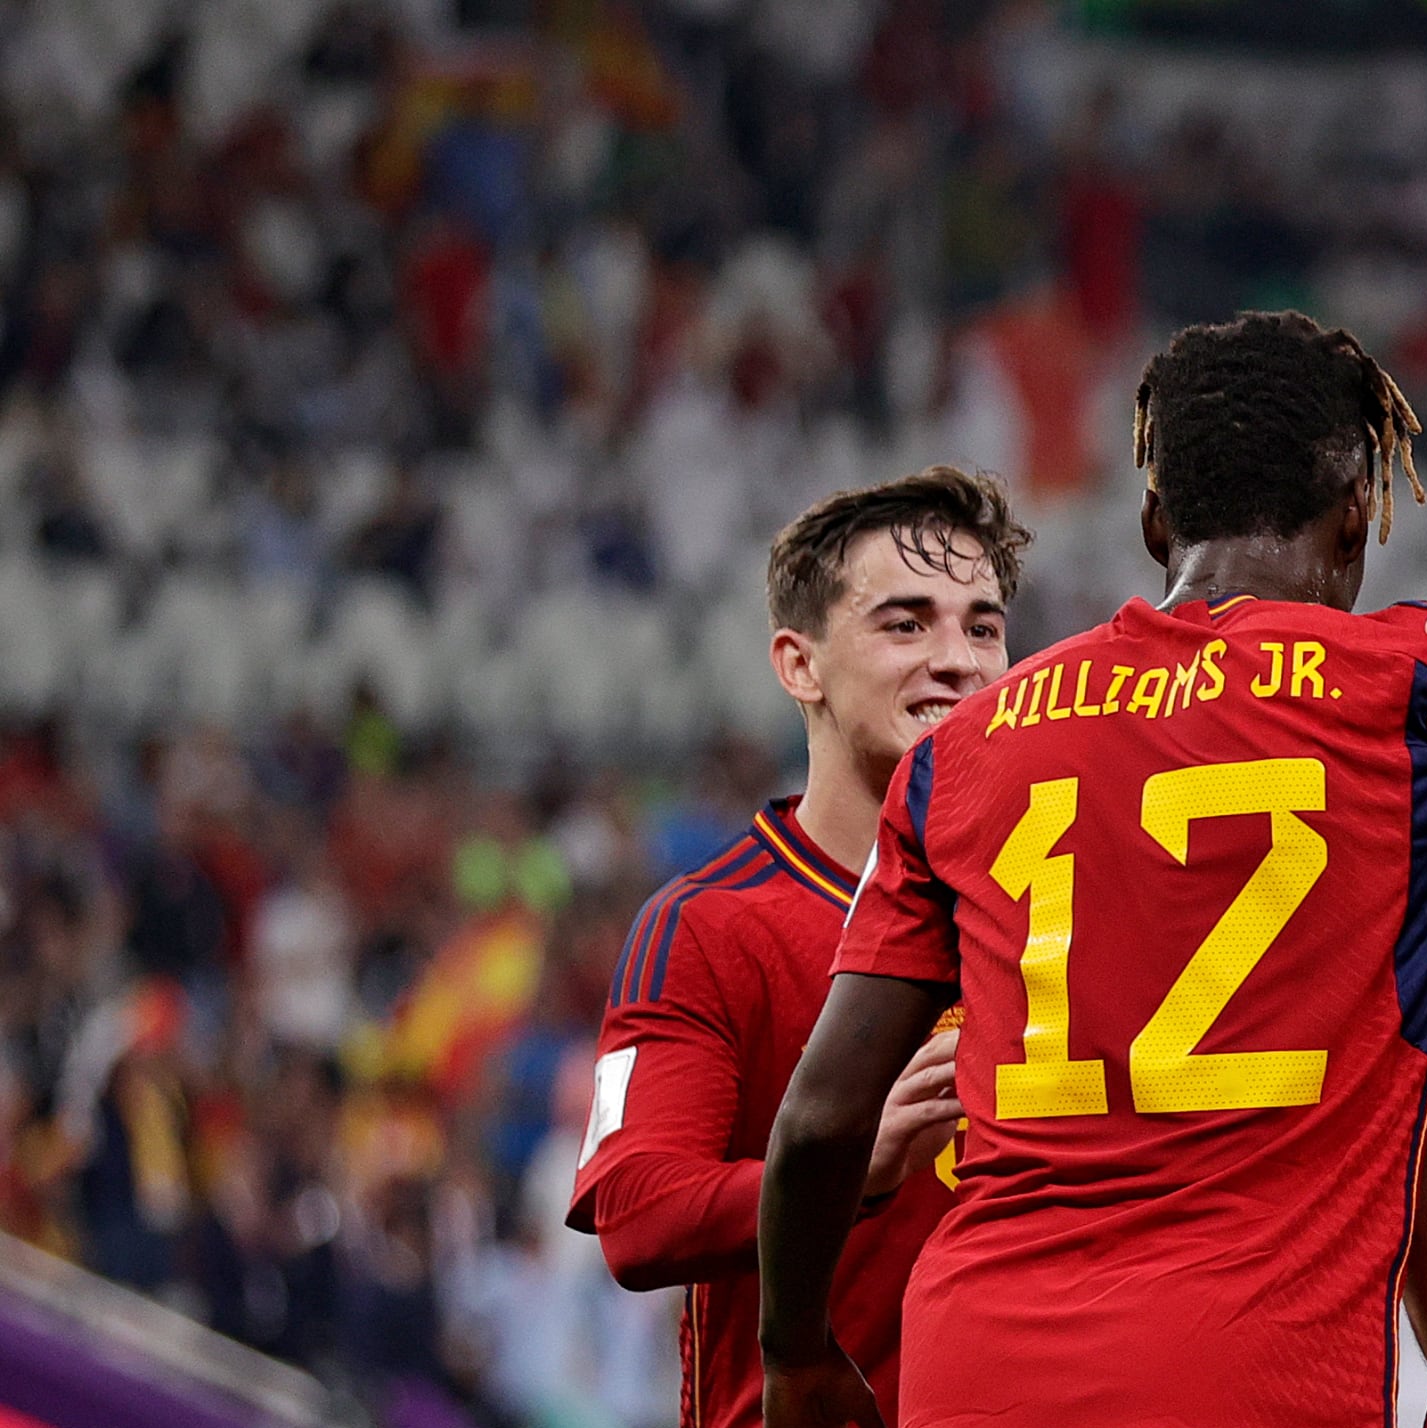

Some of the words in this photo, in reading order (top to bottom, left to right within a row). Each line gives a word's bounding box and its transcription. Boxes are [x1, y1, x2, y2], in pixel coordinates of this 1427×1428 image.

[985, 638, 1228, 739] WILLIAMS
[1250, 641, 1344, 699] JR.
[988, 757, 1330, 1121] 12
